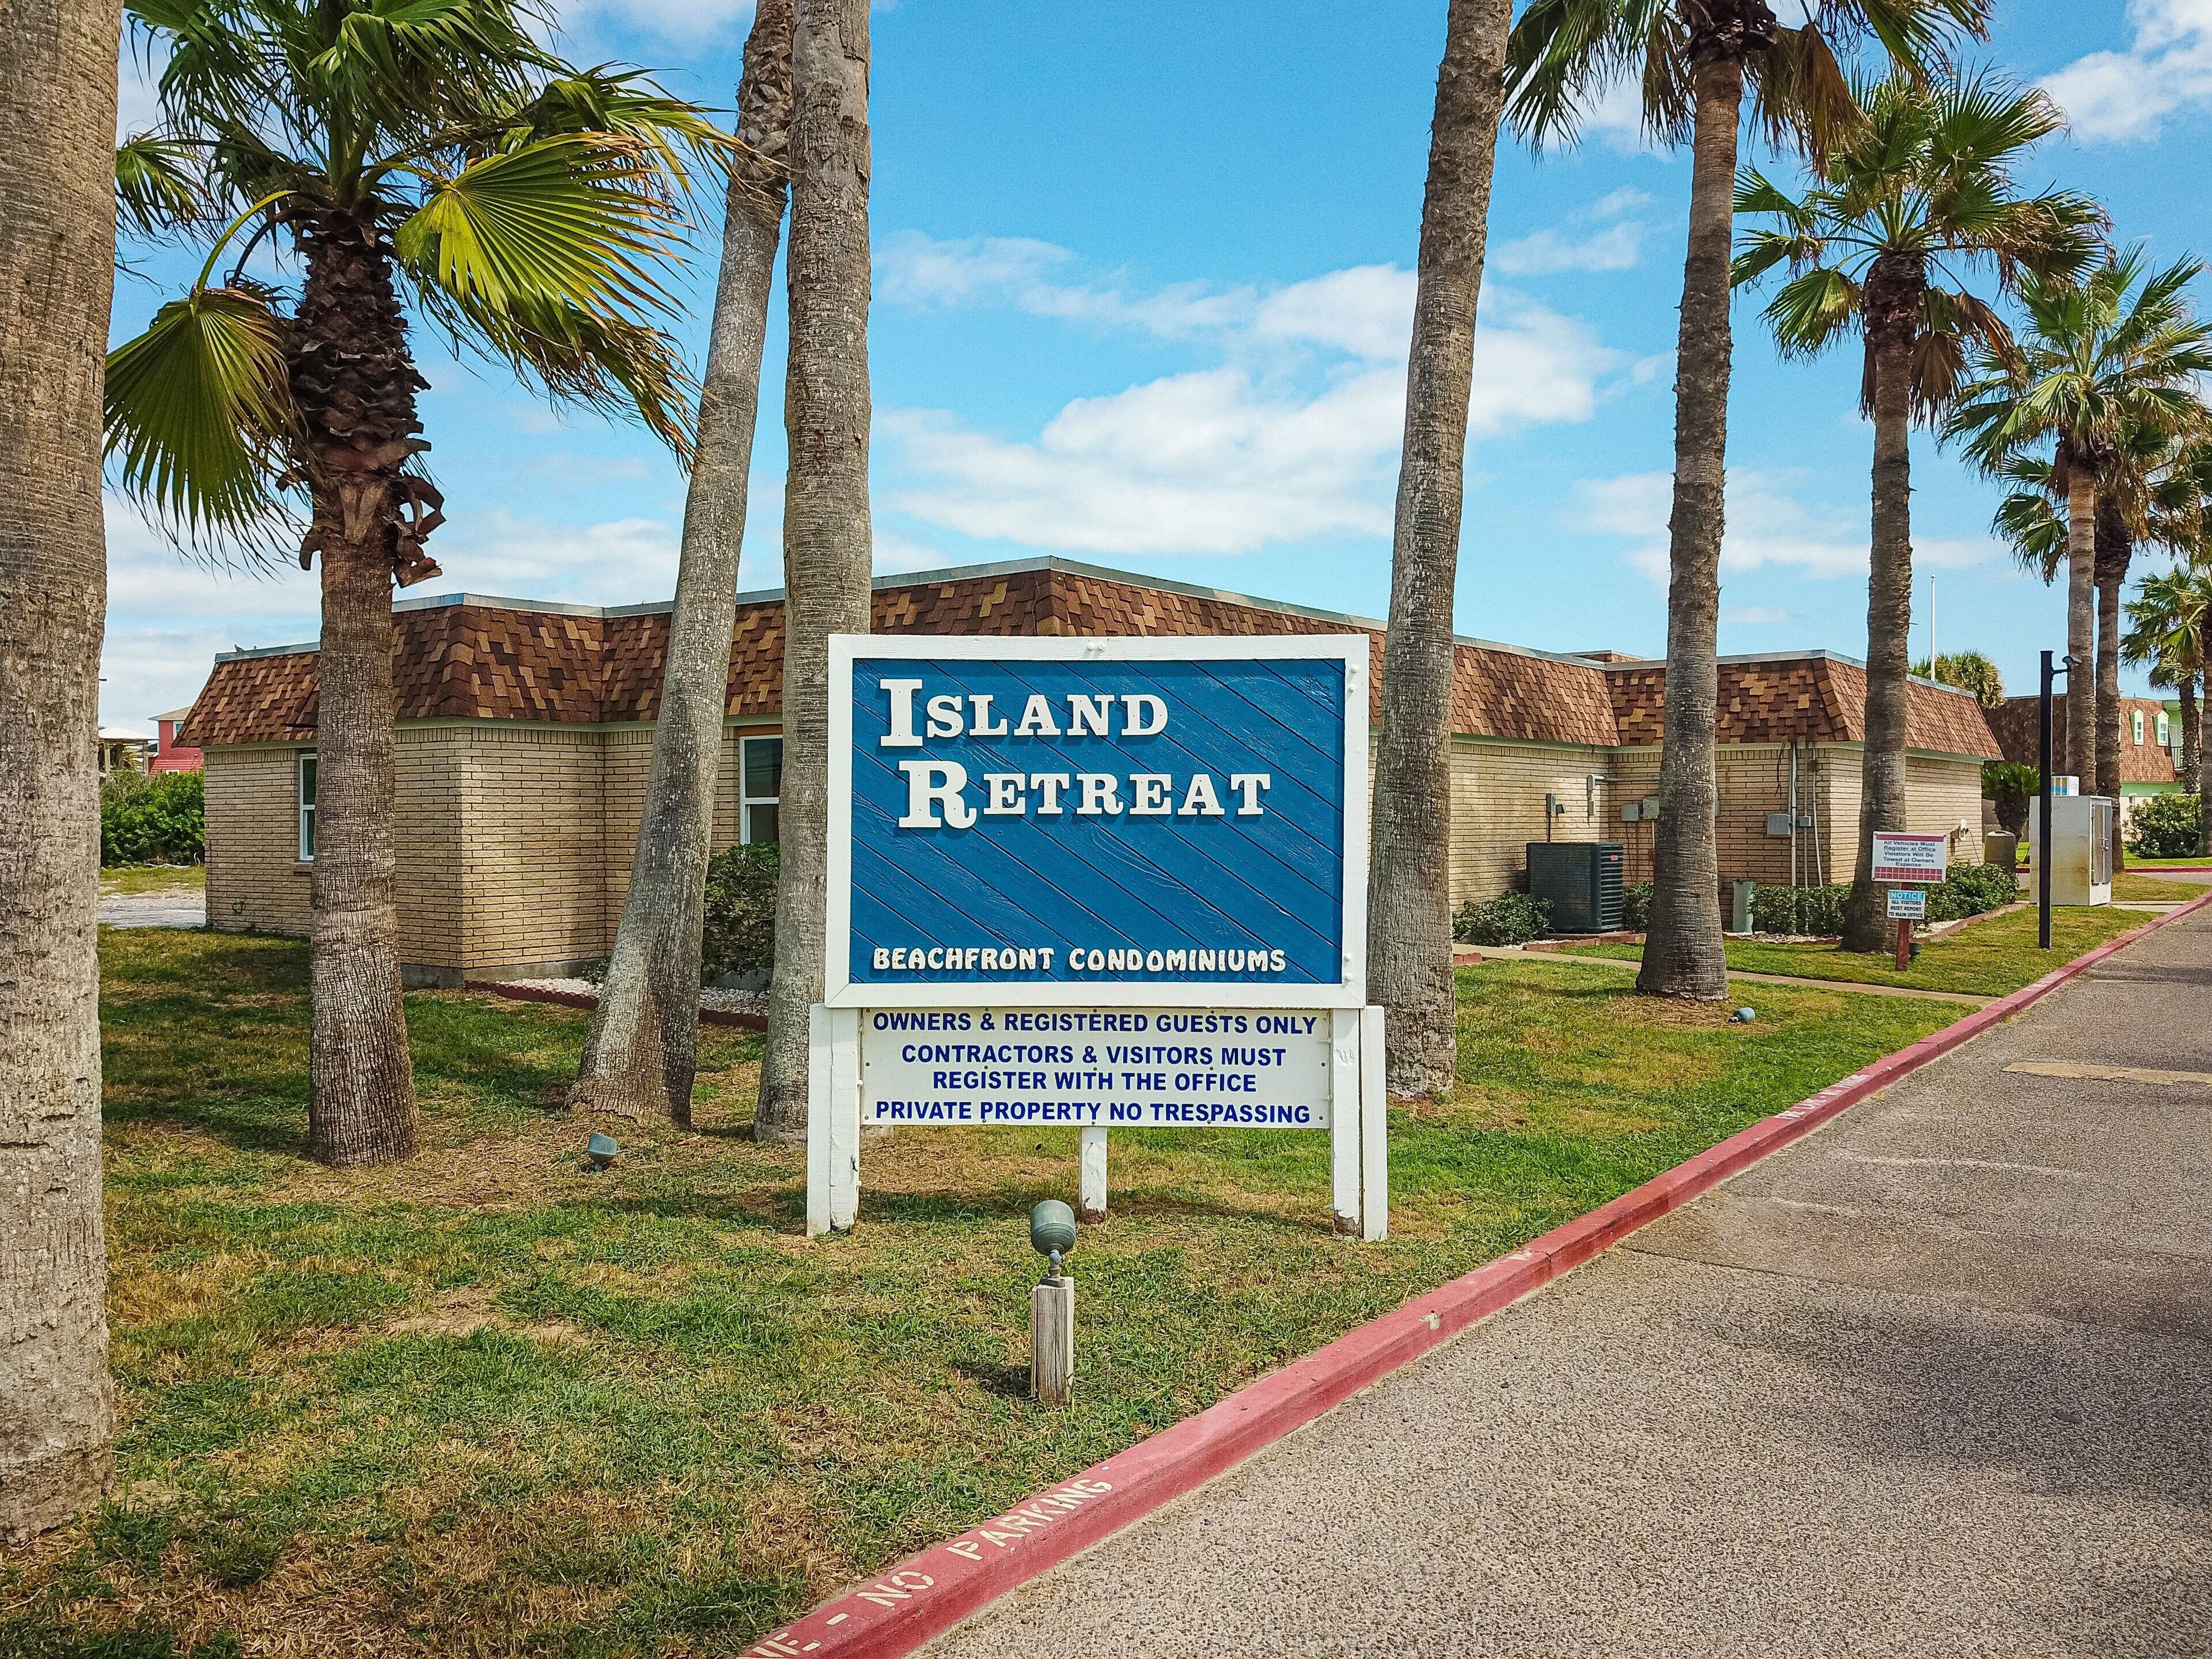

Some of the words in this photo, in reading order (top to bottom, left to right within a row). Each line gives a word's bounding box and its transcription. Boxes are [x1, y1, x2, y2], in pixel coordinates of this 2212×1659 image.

[880, 679, 1168, 747] ISLAND
[898, 759, 1271, 829] RETREAT
[1889, 892, 1923, 900] NOTICE
[873, 947, 1054, 970] BEACHFRONT
[1069, 948, 1286, 972] CONDOMINIUMS
[873, 1013, 971, 1031] OWNERS
[980, 1013, 995, 1031] &
[1005, 1014, 1148, 1032] REGISTERED
[1156, 1015, 1248, 1033] GUESTS
[1256, 1016, 1317, 1034] ONLY
[902, 1044, 1074, 1063] CONTRACTORS
[1082, 1046, 1097, 1063] &
[1107, 1046, 1213, 1065] VISITORS
[1221, 1047, 1286, 1066] MUST
[933, 1071, 1047, 1089] REGISTER
[1055, 1072, 1113, 1090] WITH
[1122, 1072, 1166, 1090] THE
[1175, 1073, 1256, 1092] OFFICE
[876, 1101, 971, 1119] PRIVATE
[980, 1101, 1101, 1120] PROPERTY
[1109, 1103, 1142, 1120] NO
[1150, 1103, 1310, 1123] TRESPASSING
[856, 1570, 935, 1607] NO
[945, 1478, 1113, 1560] PARKING
